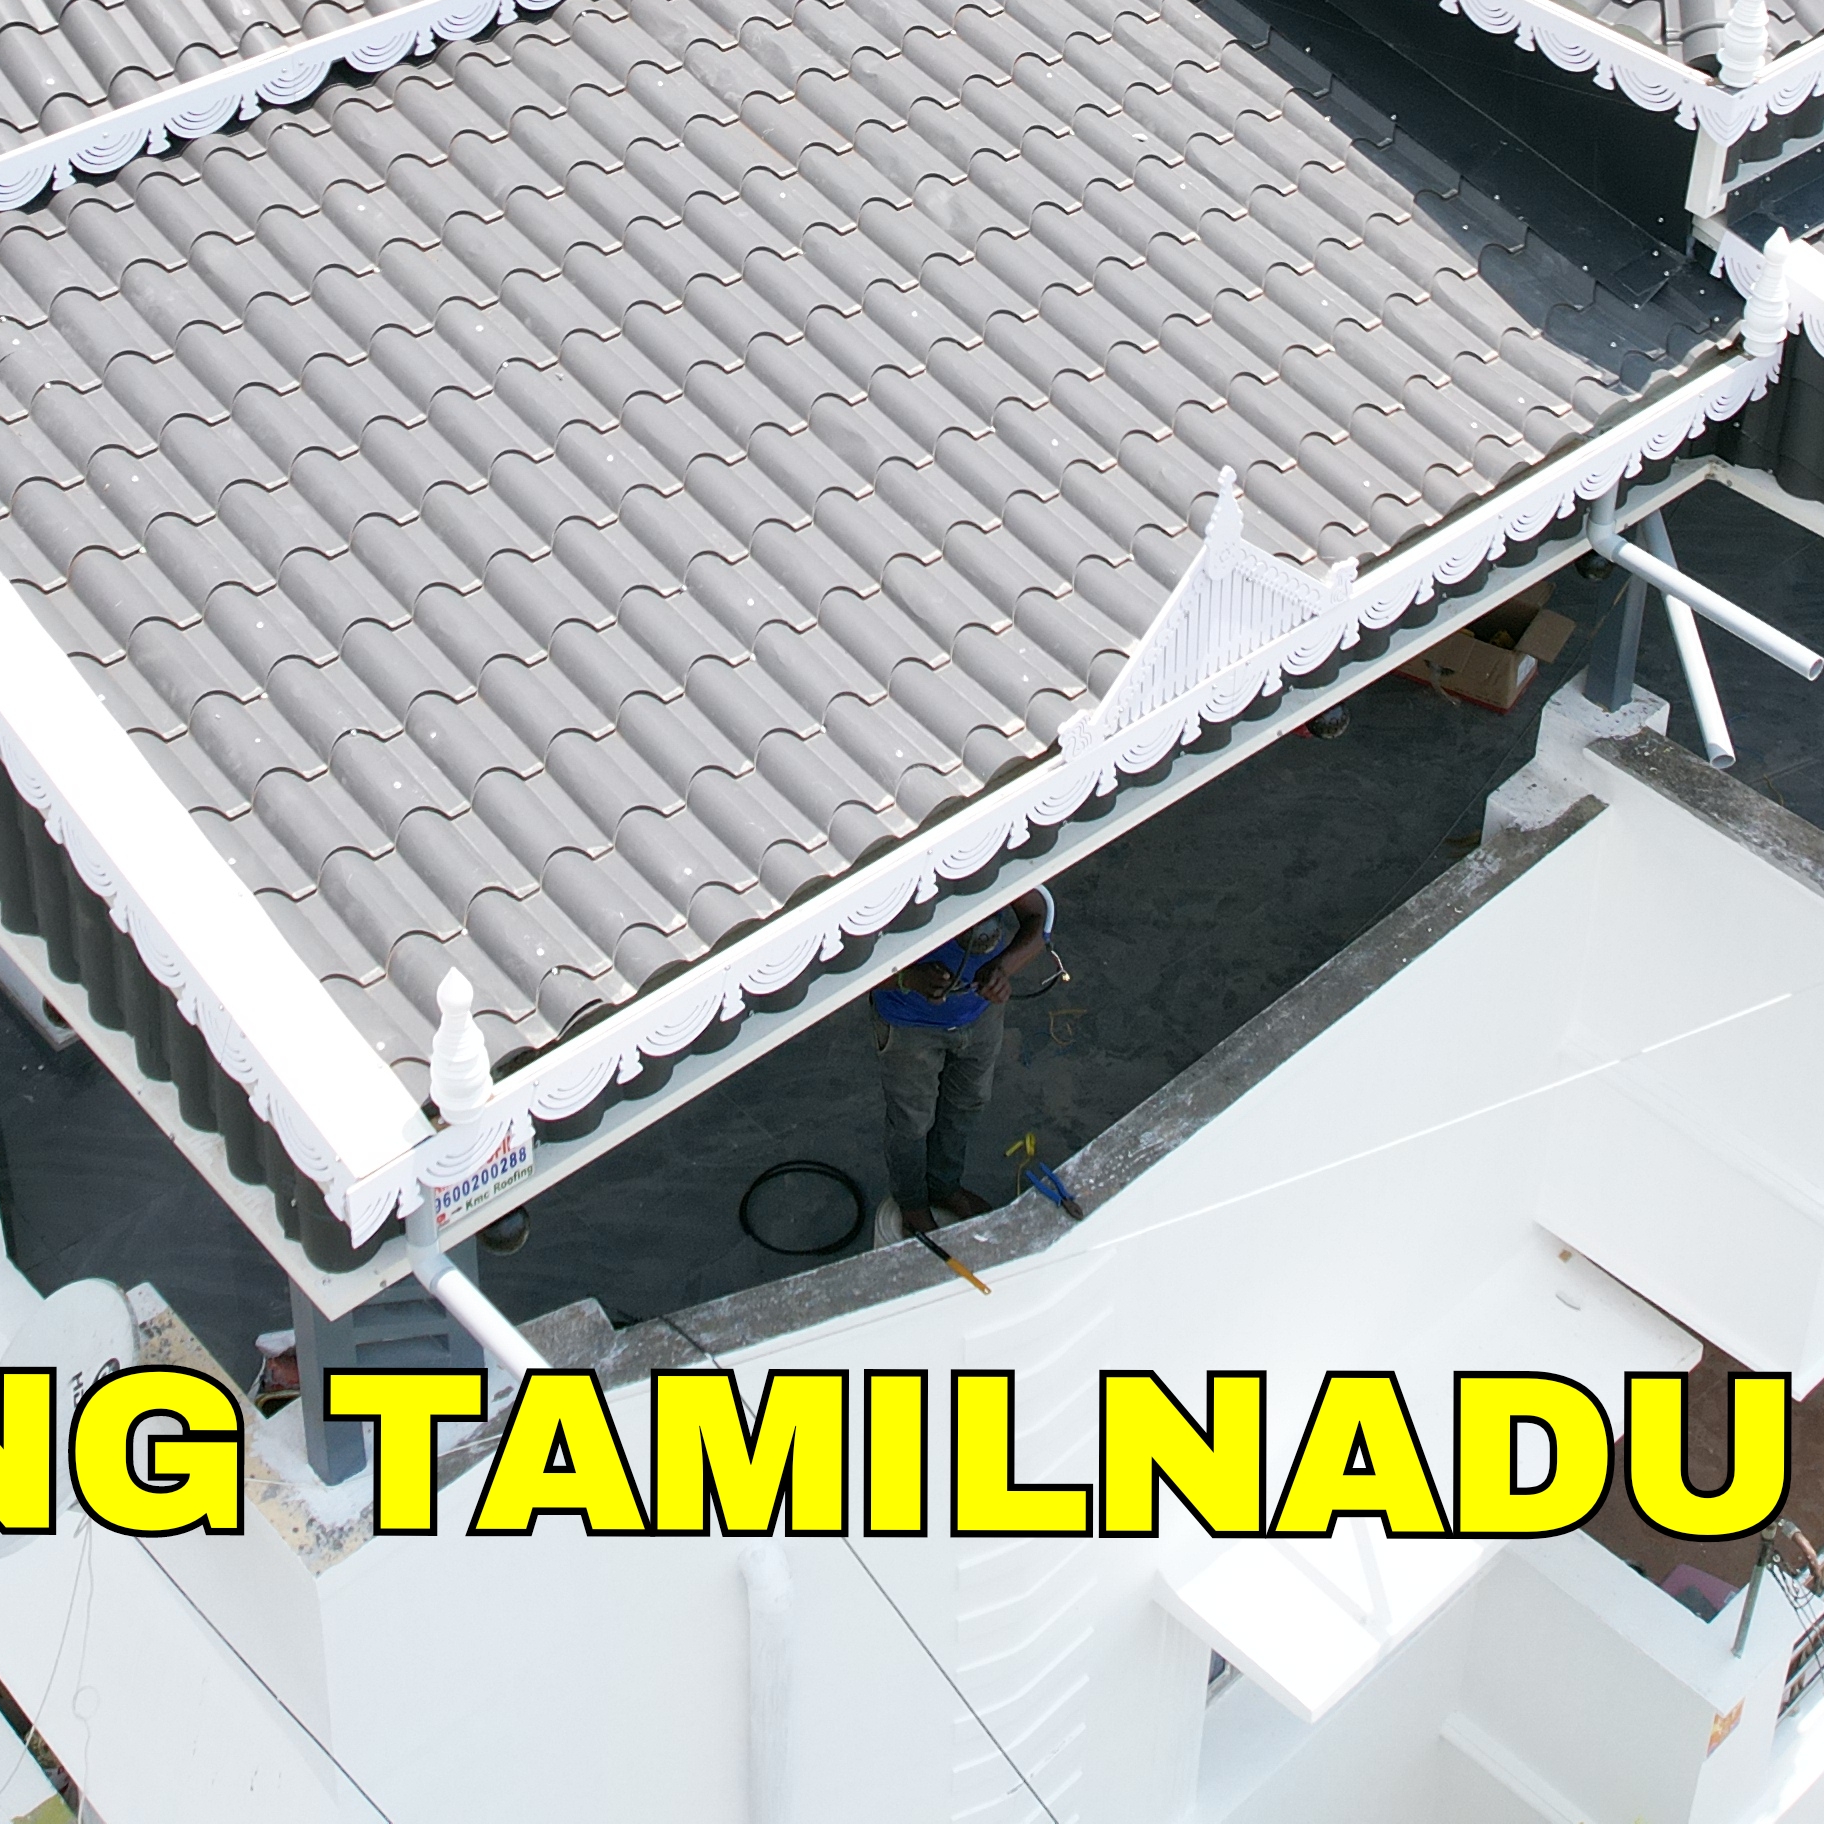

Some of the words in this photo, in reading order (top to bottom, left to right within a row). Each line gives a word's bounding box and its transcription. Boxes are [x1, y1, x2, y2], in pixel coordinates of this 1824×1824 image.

[435, 1146, 526, 1213] 9600200288
[465, 1191, 490, 1210] Kmc
[493, 1165, 533, 1194] Roofing
